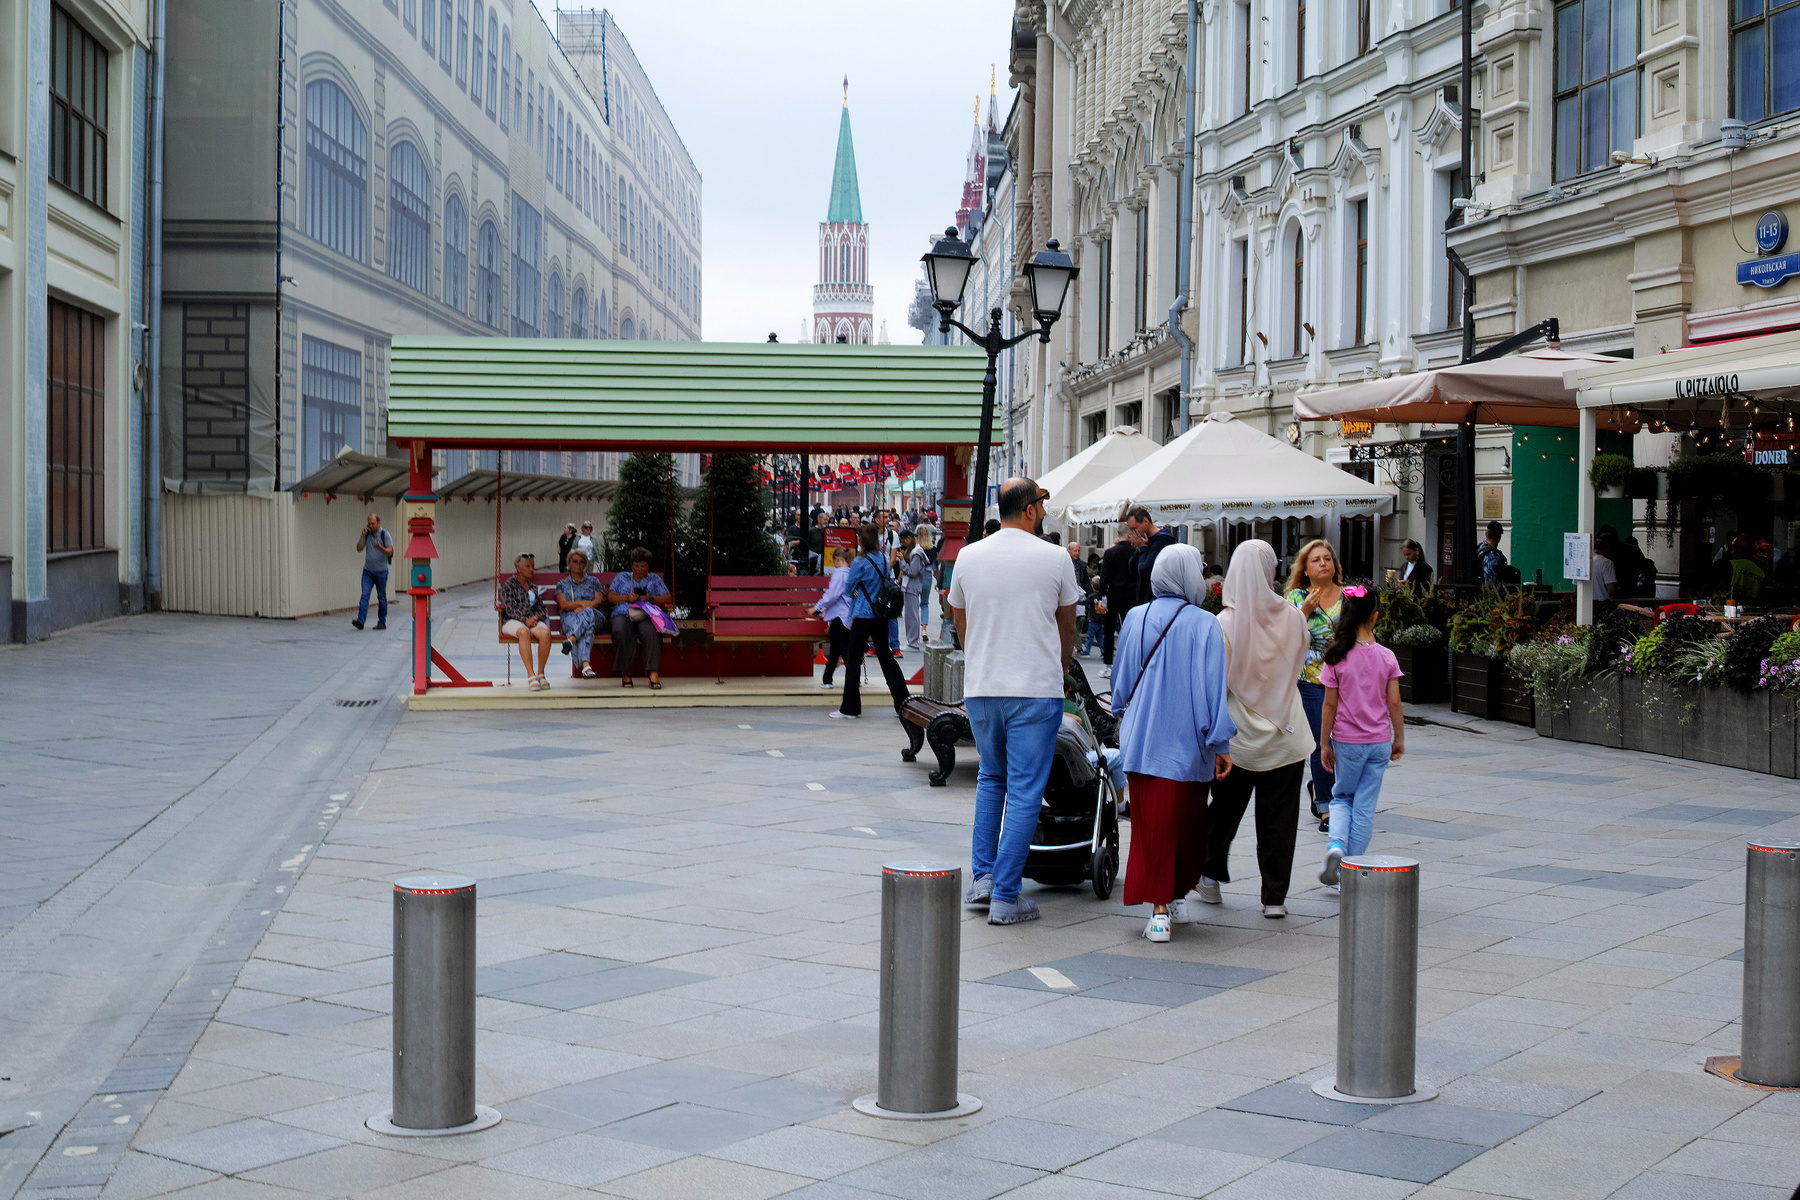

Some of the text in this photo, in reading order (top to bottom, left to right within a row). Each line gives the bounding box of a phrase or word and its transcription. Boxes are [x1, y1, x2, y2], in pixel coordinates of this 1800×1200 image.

[1759, 222, 1778, 239] 11-13
[1751, 260, 1786, 275] НИКОЛЬСКАЯ
[1675, 373, 1739, 398] IL PIZZAIOLO
[1754, 449, 1788, 465] DONER
